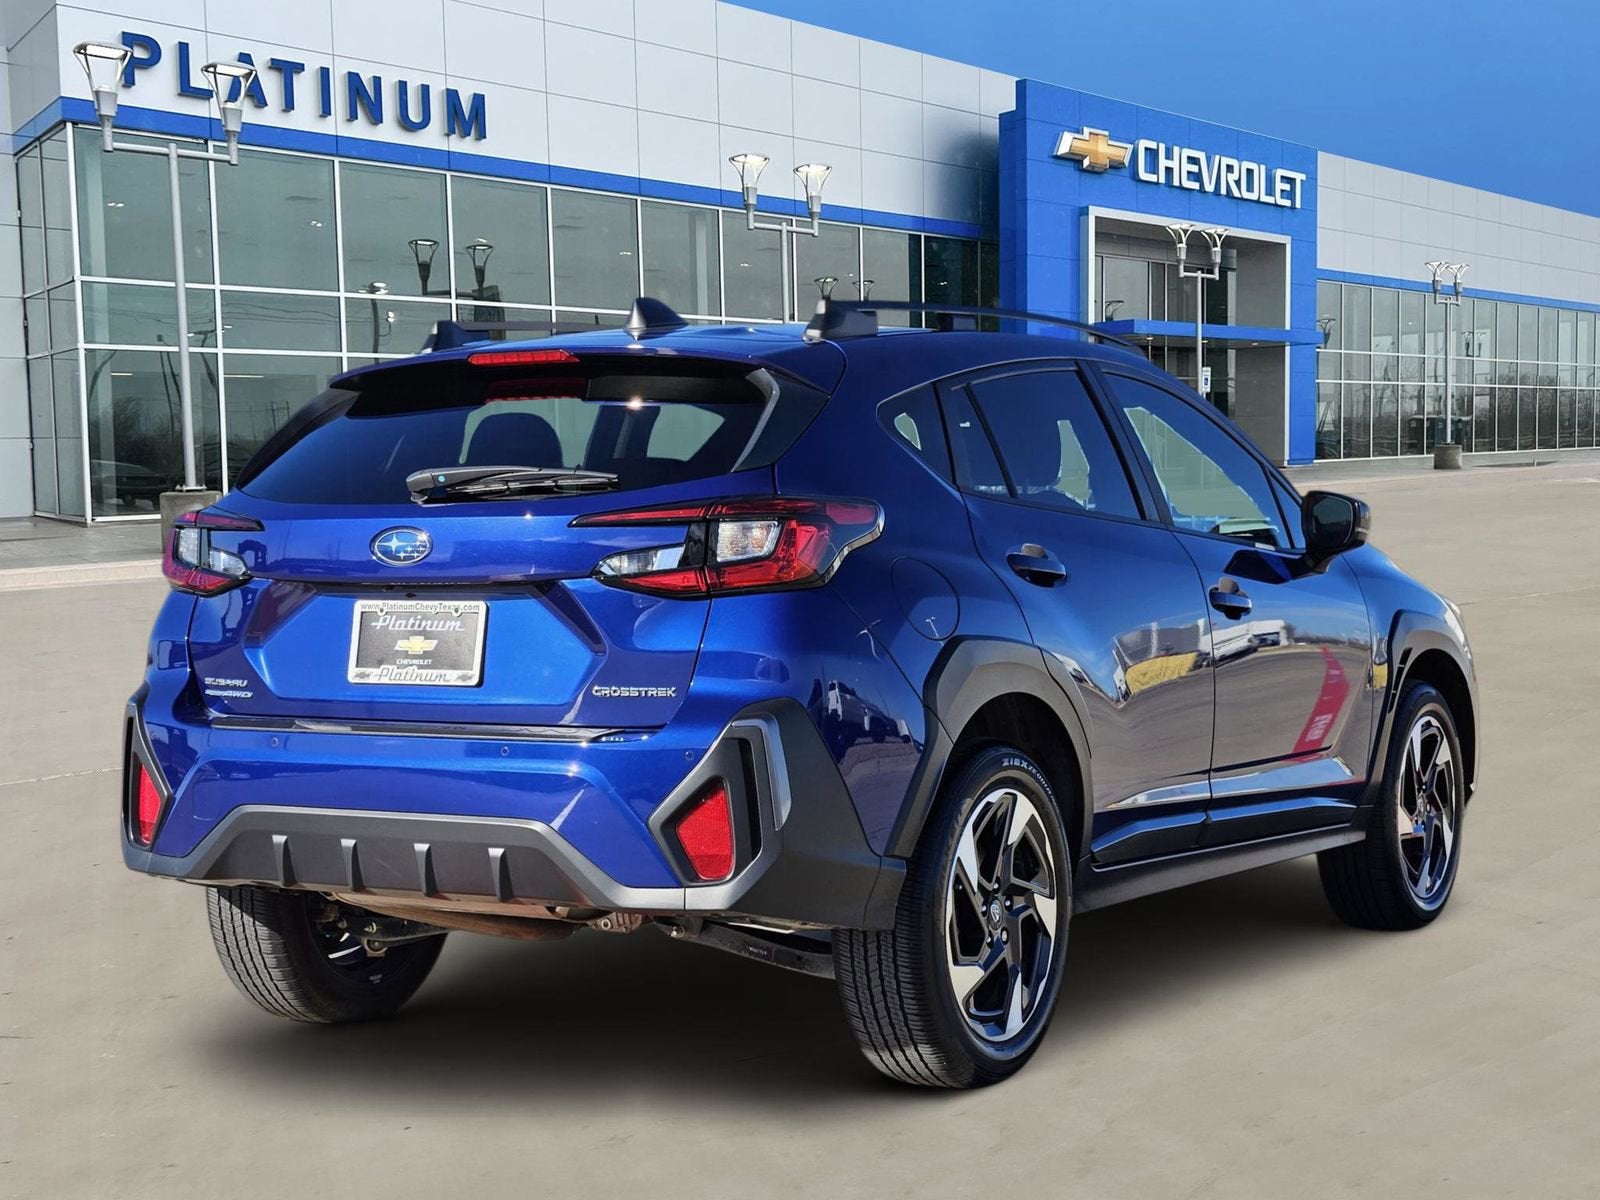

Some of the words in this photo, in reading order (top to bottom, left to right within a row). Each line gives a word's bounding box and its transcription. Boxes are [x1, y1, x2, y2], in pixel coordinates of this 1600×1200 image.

[121, 31, 487, 140] PLATINUM
[1136, 139, 1306, 208] CHEVROLET
[371, 614, 465, 631] Platinum
[204, 677, 248, 687] SUBARU
[375, 667, 451, 682] Platinum
[592, 685, 677, 697] CROSSTREK
